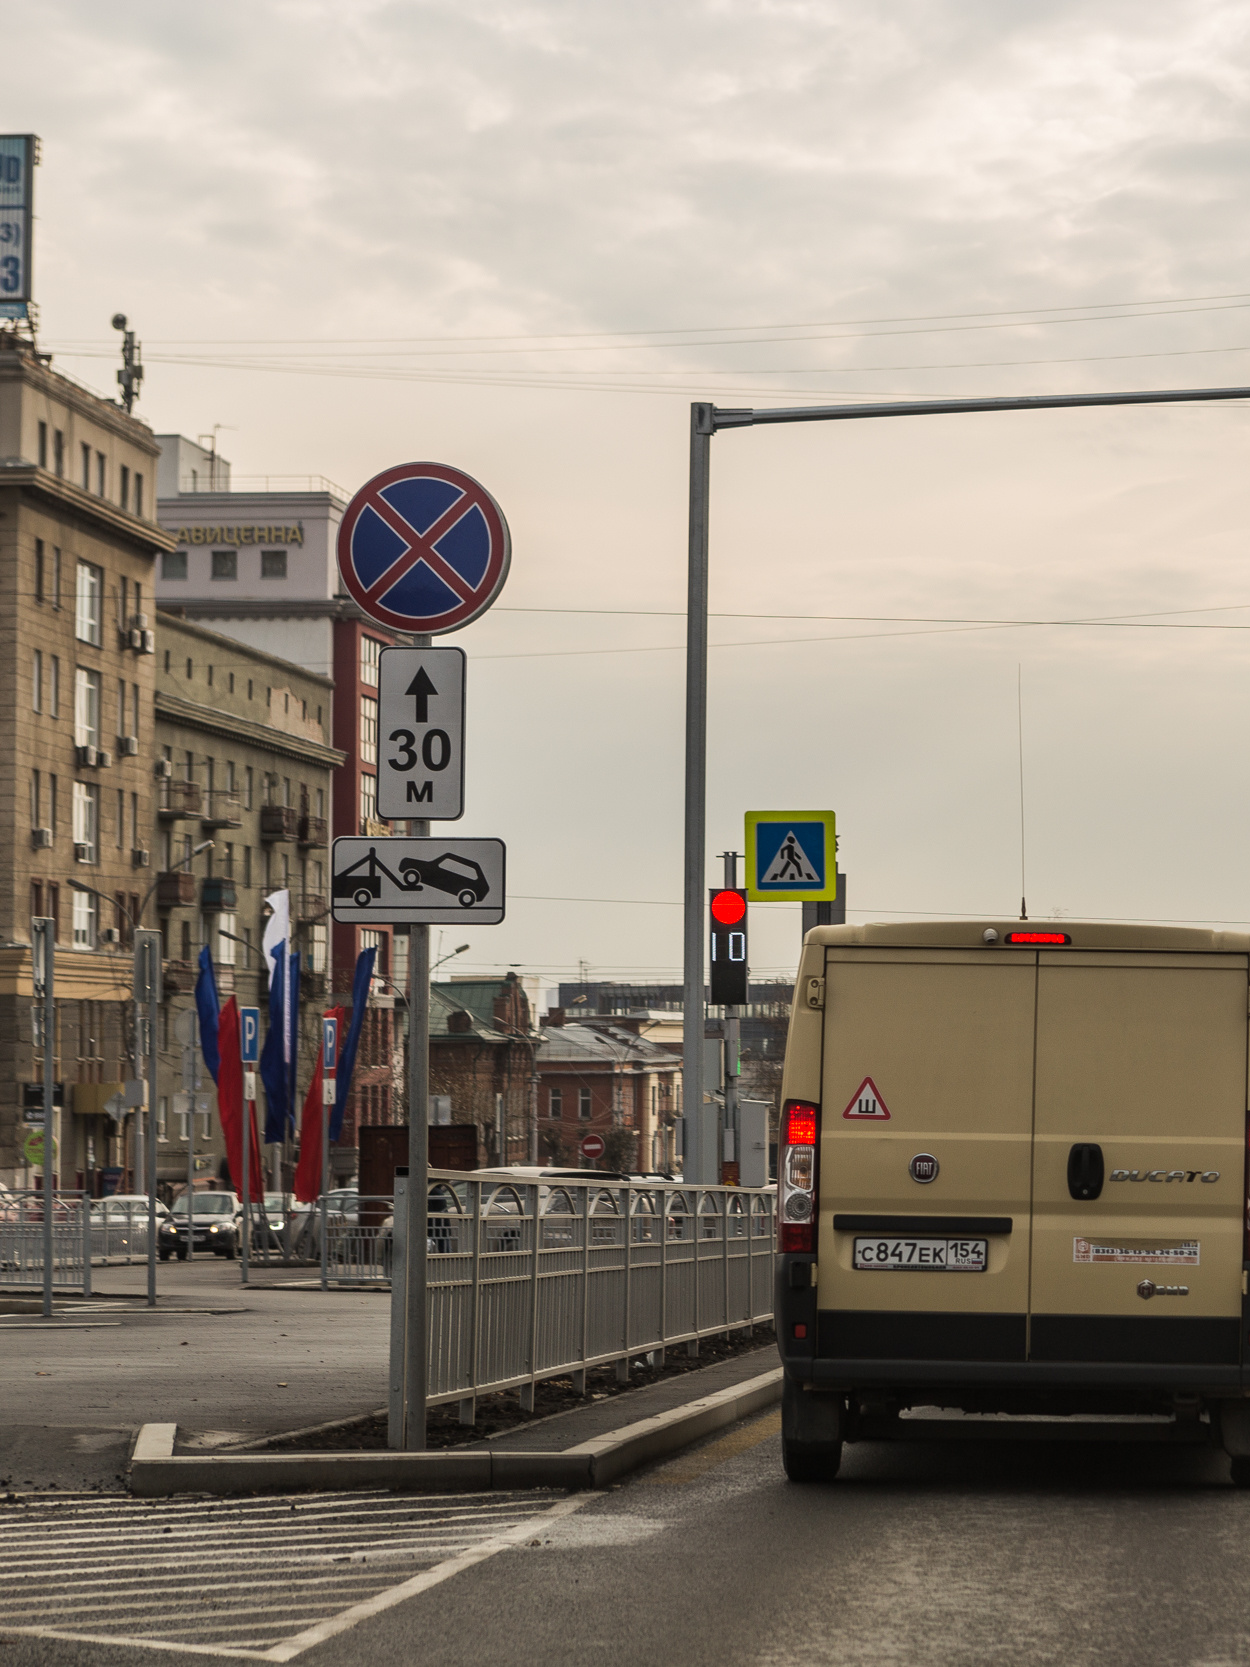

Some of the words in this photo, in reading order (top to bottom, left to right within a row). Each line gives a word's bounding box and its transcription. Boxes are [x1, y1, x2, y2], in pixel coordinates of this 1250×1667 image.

[178, 526, 303, 548] АВИЦЕННА
[388, 728, 451, 772] 30
[712, 932, 745, 961] 10
[858, 1099, 876, 1114] Ш
[916, 1162, 932, 1175] FIAT
[1109, 1169, 1220, 1183] DUCATO
[861, 1242, 944, 1263] С847ЕК
[949, 1242, 982, 1258] 154
